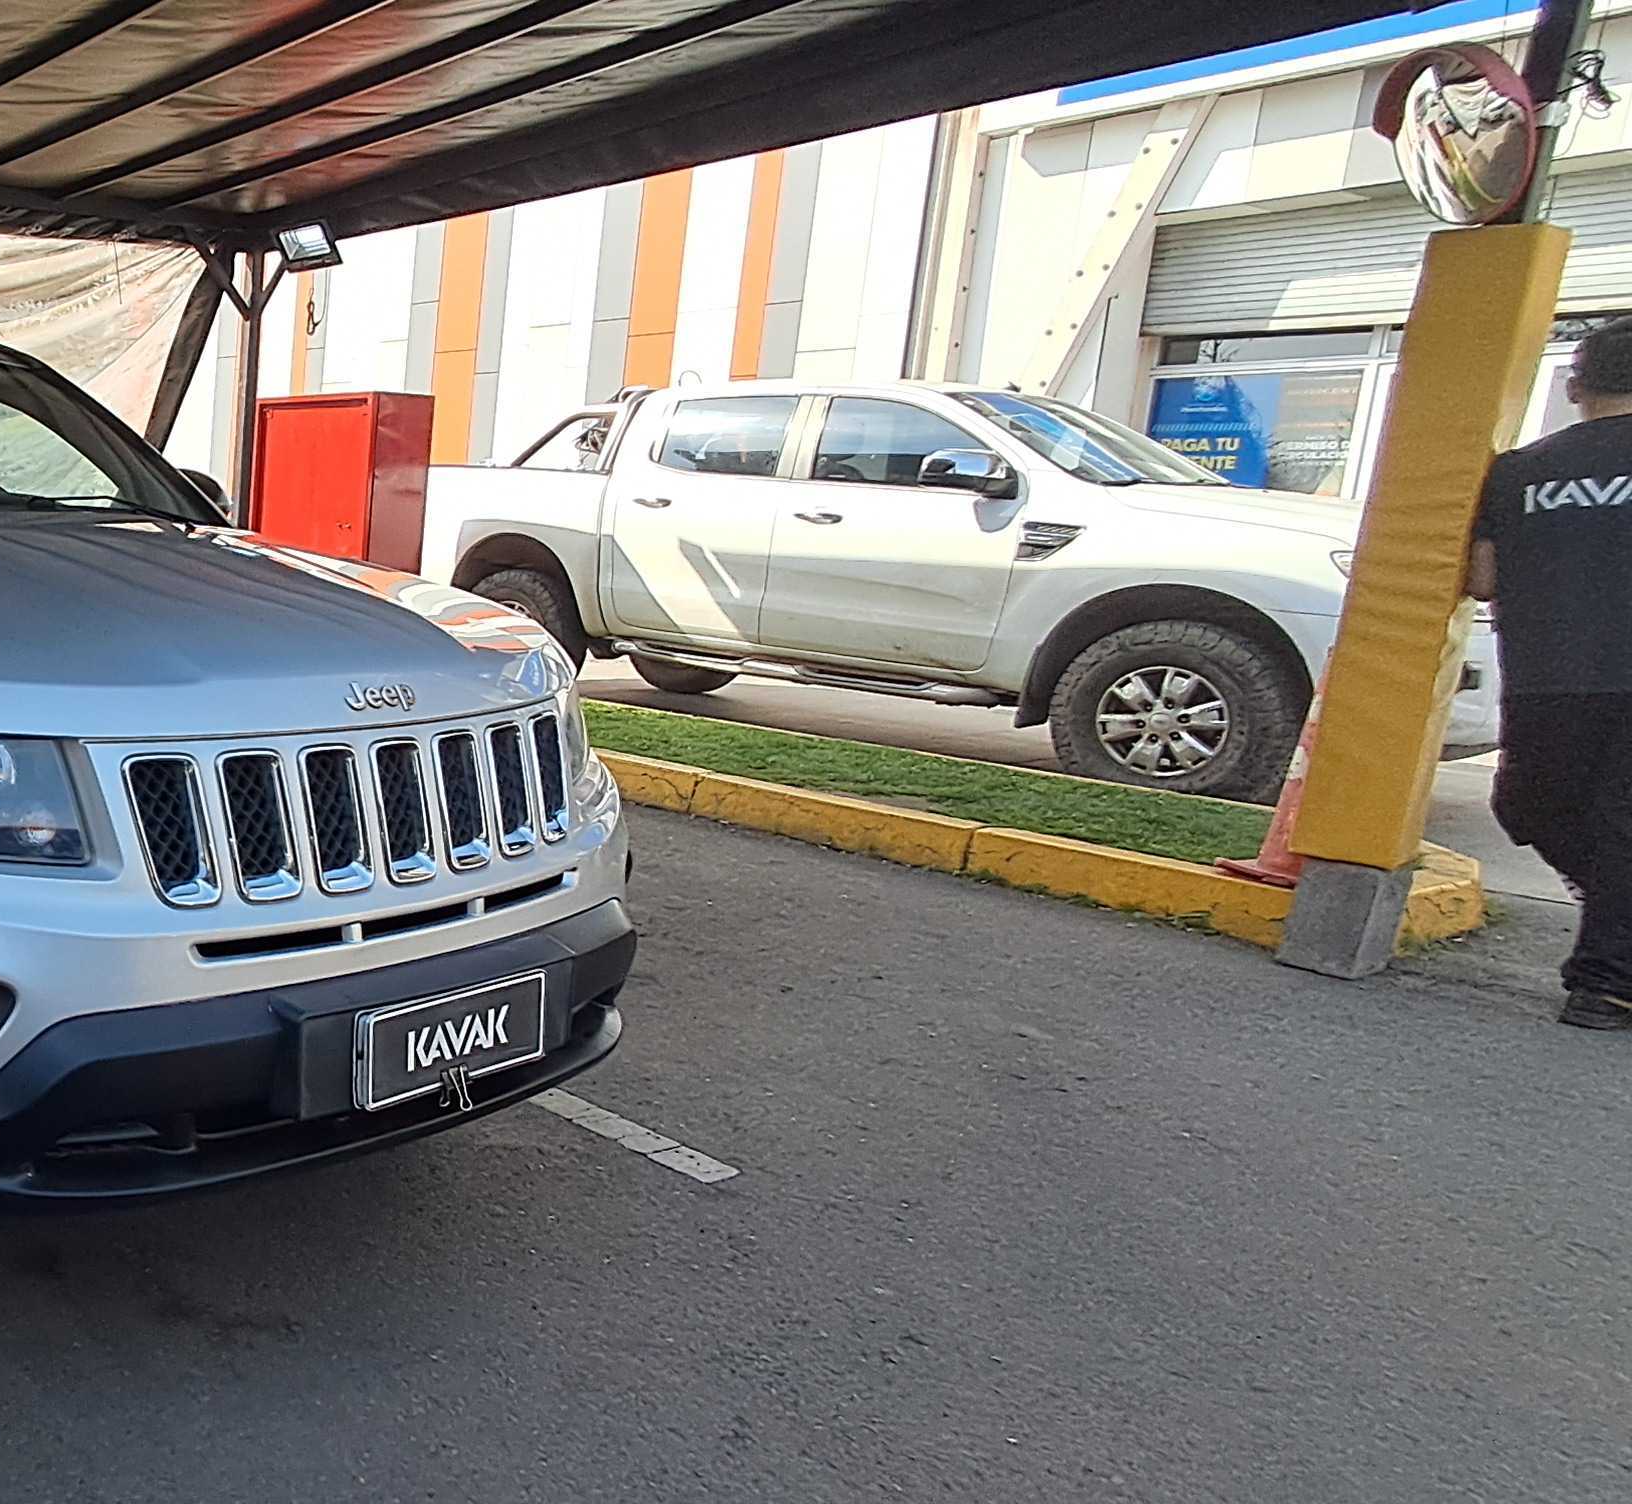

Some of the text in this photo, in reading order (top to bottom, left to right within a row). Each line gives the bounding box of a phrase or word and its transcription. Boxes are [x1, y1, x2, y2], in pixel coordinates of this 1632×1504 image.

[1215, 437, 1241, 451] TU
[1188, 456, 1237, 471] ENTE
[1524, 476, 1632, 514] KAVA
[344, 681, 416, 712] Jeep
[407, 1004, 510, 1073] KAVAK
